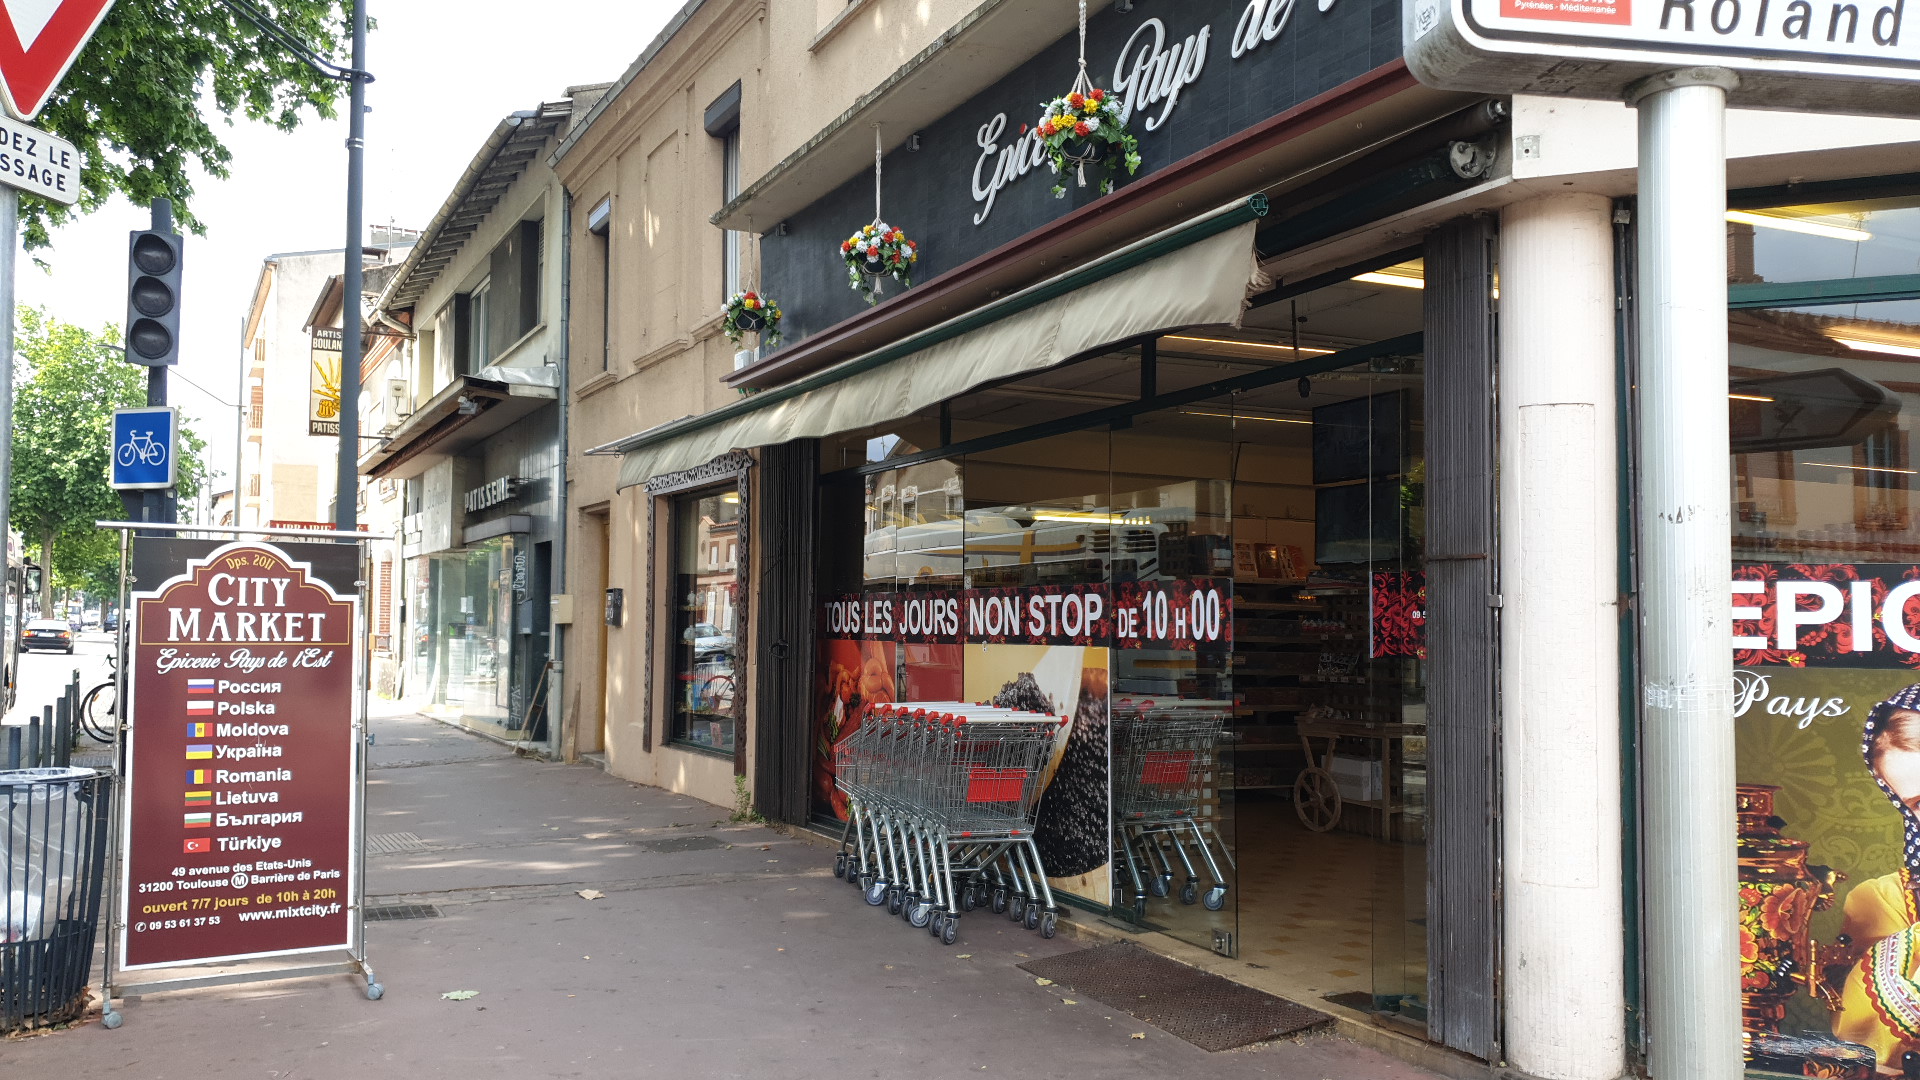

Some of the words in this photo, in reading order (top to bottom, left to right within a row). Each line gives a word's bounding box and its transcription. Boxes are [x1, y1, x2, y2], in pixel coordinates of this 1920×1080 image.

[1560, 2, 1617, 14] Méditerranée
[1112, 17, 1211, 132] Pays
[49, 145, 71, 170] LE
[0, 153, 66, 192] SSAGE
[464, 474, 510, 514] PATISSERIE
[208, 572, 291, 607] CITY
[167, 607, 326, 641] MARKET
[824, 600, 860, 634] TOUS
[864, 600, 892, 634] LES
[899, 598, 958, 635] JOURS
[969, 596, 1020, 636] NON
[1028, 593, 1103, 637] STOP
[1118, 607, 1138, 638] DE
[1142, 590, 1168, 640] 10
[1175, 607, 1186, 639] H
[1191, 589, 1220, 641] 00
[156, 648, 221, 674] Epicerie
[224, 647, 265, 674] Pays
[267, 650, 288, 668] de
[218, 680, 282, 694] Россия
[217, 700, 275, 715] Polska
[1733, 669, 1851, 729] Pays
[216, 722, 289, 737] Moldova
[215, 744, 282, 761] Україна
[216, 768, 292, 784] Romania
[215, 790, 279, 806] Lietuva
[216, 811, 303, 827] България
[217, 836, 282, 852] Türkiye
[171, 867, 186, 876] 49
[188, 865, 230, 876] avenue
[232, 863, 253, 872] des
[255, 858, 312, 871] Etats-Unis
[138, 881, 173, 893] 31200
[176, 879, 229, 890] Toulouse
[251, 872, 294, 885] Barrière
[297, 872, 311, 881] de
[313, 869, 340, 880] Paris
[142, 900, 188, 914] ouvert
[191, 897, 212, 910] 7/7
[213, 896, 249, 911] jours
[256, 893, 273, 904] de
[276, 891, 299, 902] 10h
[302, 890, 310, 901] à
[313, 888, 336, 900] 20h
[238, 902, 341, 922] www.mixtcity.fr
[149, 921, 162, 931] 09
[164, 920, 177, 929] 53
[179, 918, 191, 928] 61
[194, 917, 206, 926] 37
[208, 916, 221, 925] 53
